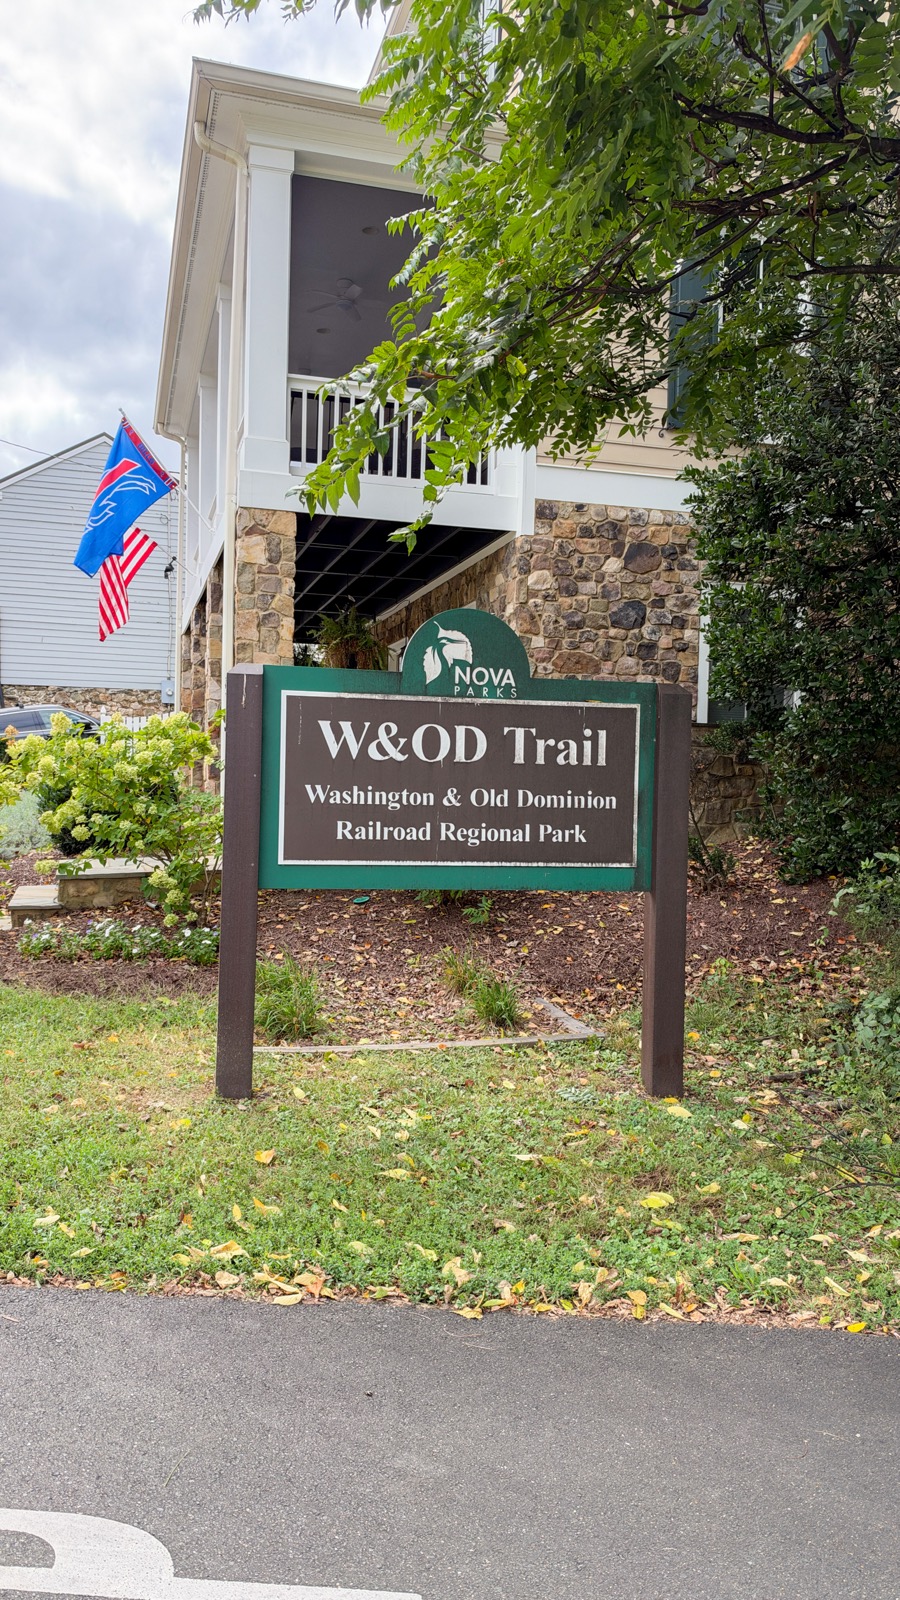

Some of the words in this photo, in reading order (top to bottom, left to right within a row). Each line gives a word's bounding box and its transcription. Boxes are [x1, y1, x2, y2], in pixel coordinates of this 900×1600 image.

[454, 665, 516, 687] NOVA
[454, 685, 517, 698] PARKS
[317, 719, 488, 763] W&OD
[503, 726, 607, 766] Trail
[304, 784, 435, 810] Washington
[442, 787, 462, 807] &
[470, 788, 509, 808] Old
[517, 789, 617, 809] Dominion
[336, 820, 431, 841] Railroad
[440, 822, 531, 846] Regional
[538, 823, 587, 843] Park
